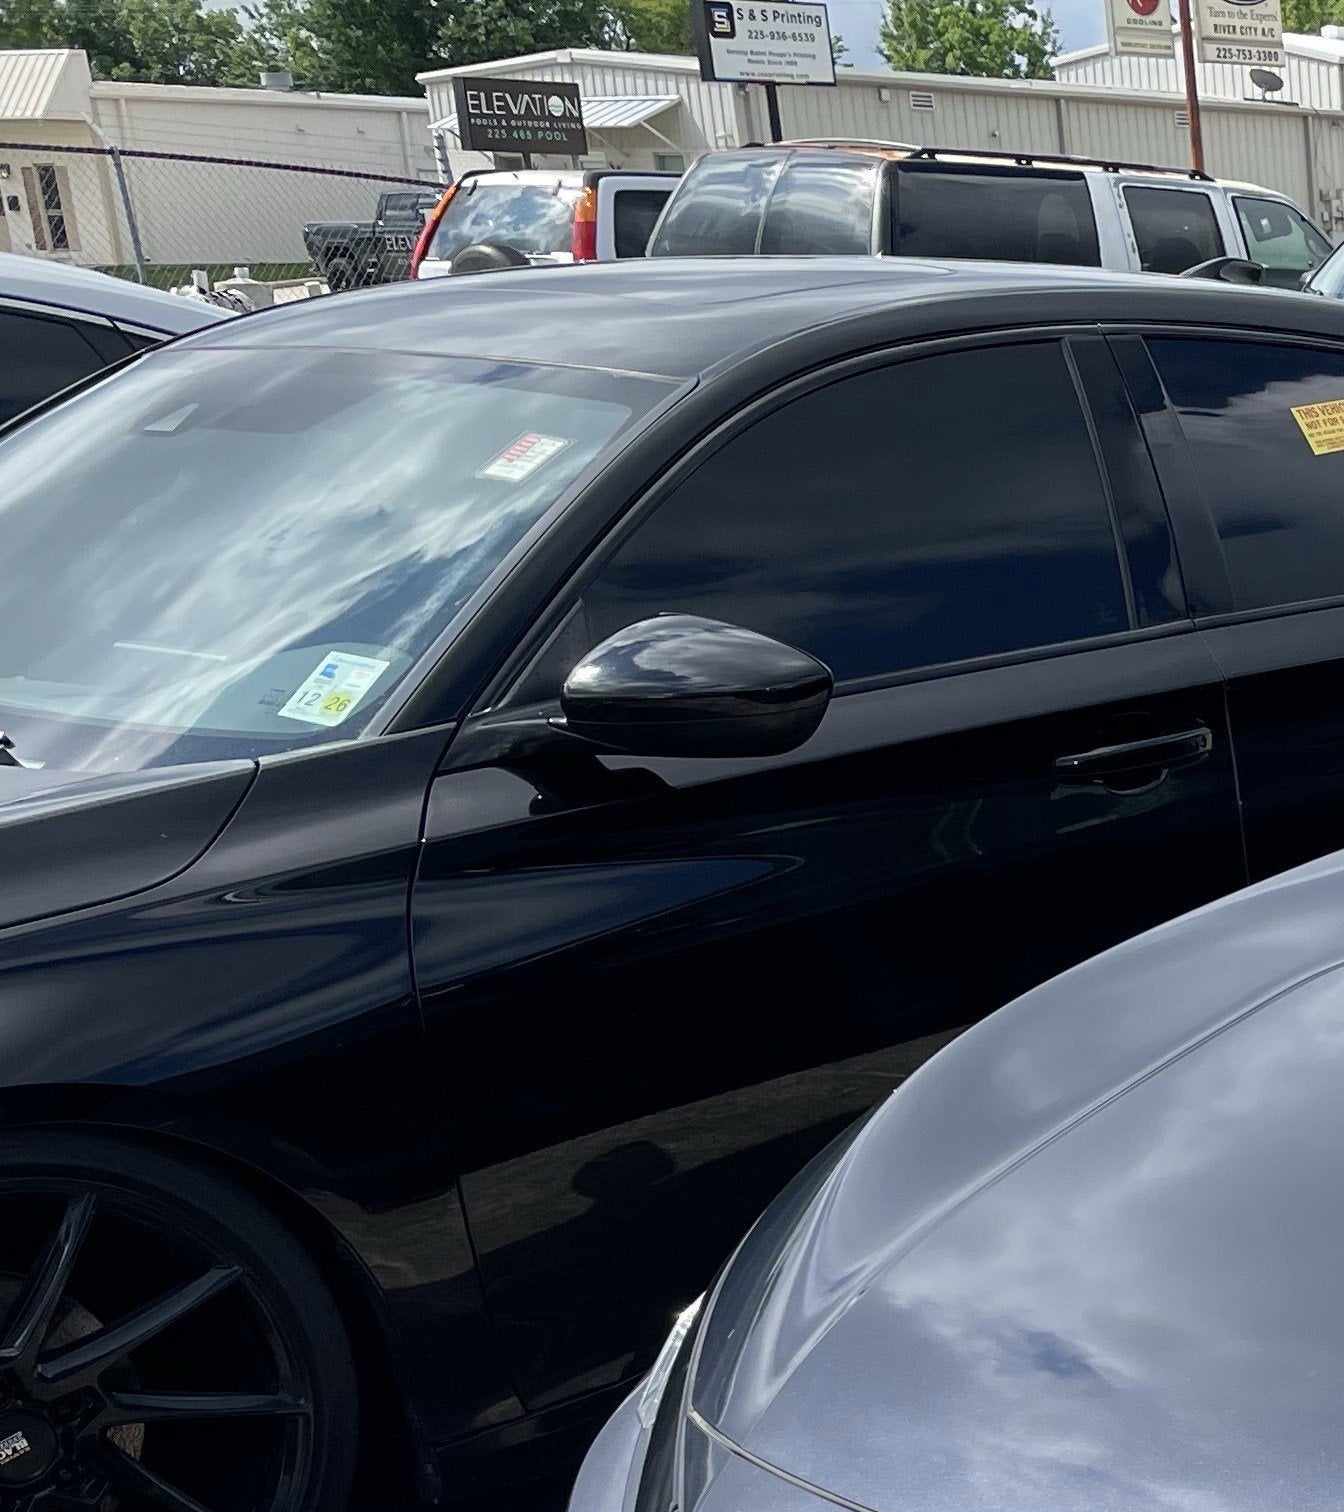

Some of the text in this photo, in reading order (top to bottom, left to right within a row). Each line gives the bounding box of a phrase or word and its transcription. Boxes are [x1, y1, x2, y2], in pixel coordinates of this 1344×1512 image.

[736, 7, 823, 28] S & S Printing
[1206, 6, 1226, 18] Turn
[1237, 7, 1248, 19] the
[1213, 23, 1275, 38] RIVER CITY A/C
[1216, 47, 1280, 62] 225-753-3300
[466, 90, 580, 118] ELEVATION
[470, 117, 582, 130] POOLS & OUTDOOR LIVING
[487, 128, 508, 139] 225
[537, 131, 569, 142] POOL
[1295, 406, 1320, 421] THIS
[1304, 420, 1322, 431] NOT
[1322, 416, 1340, 427] FOR
[297, 690, 322, 707] 12
[324, 696, 351, 713] 26
